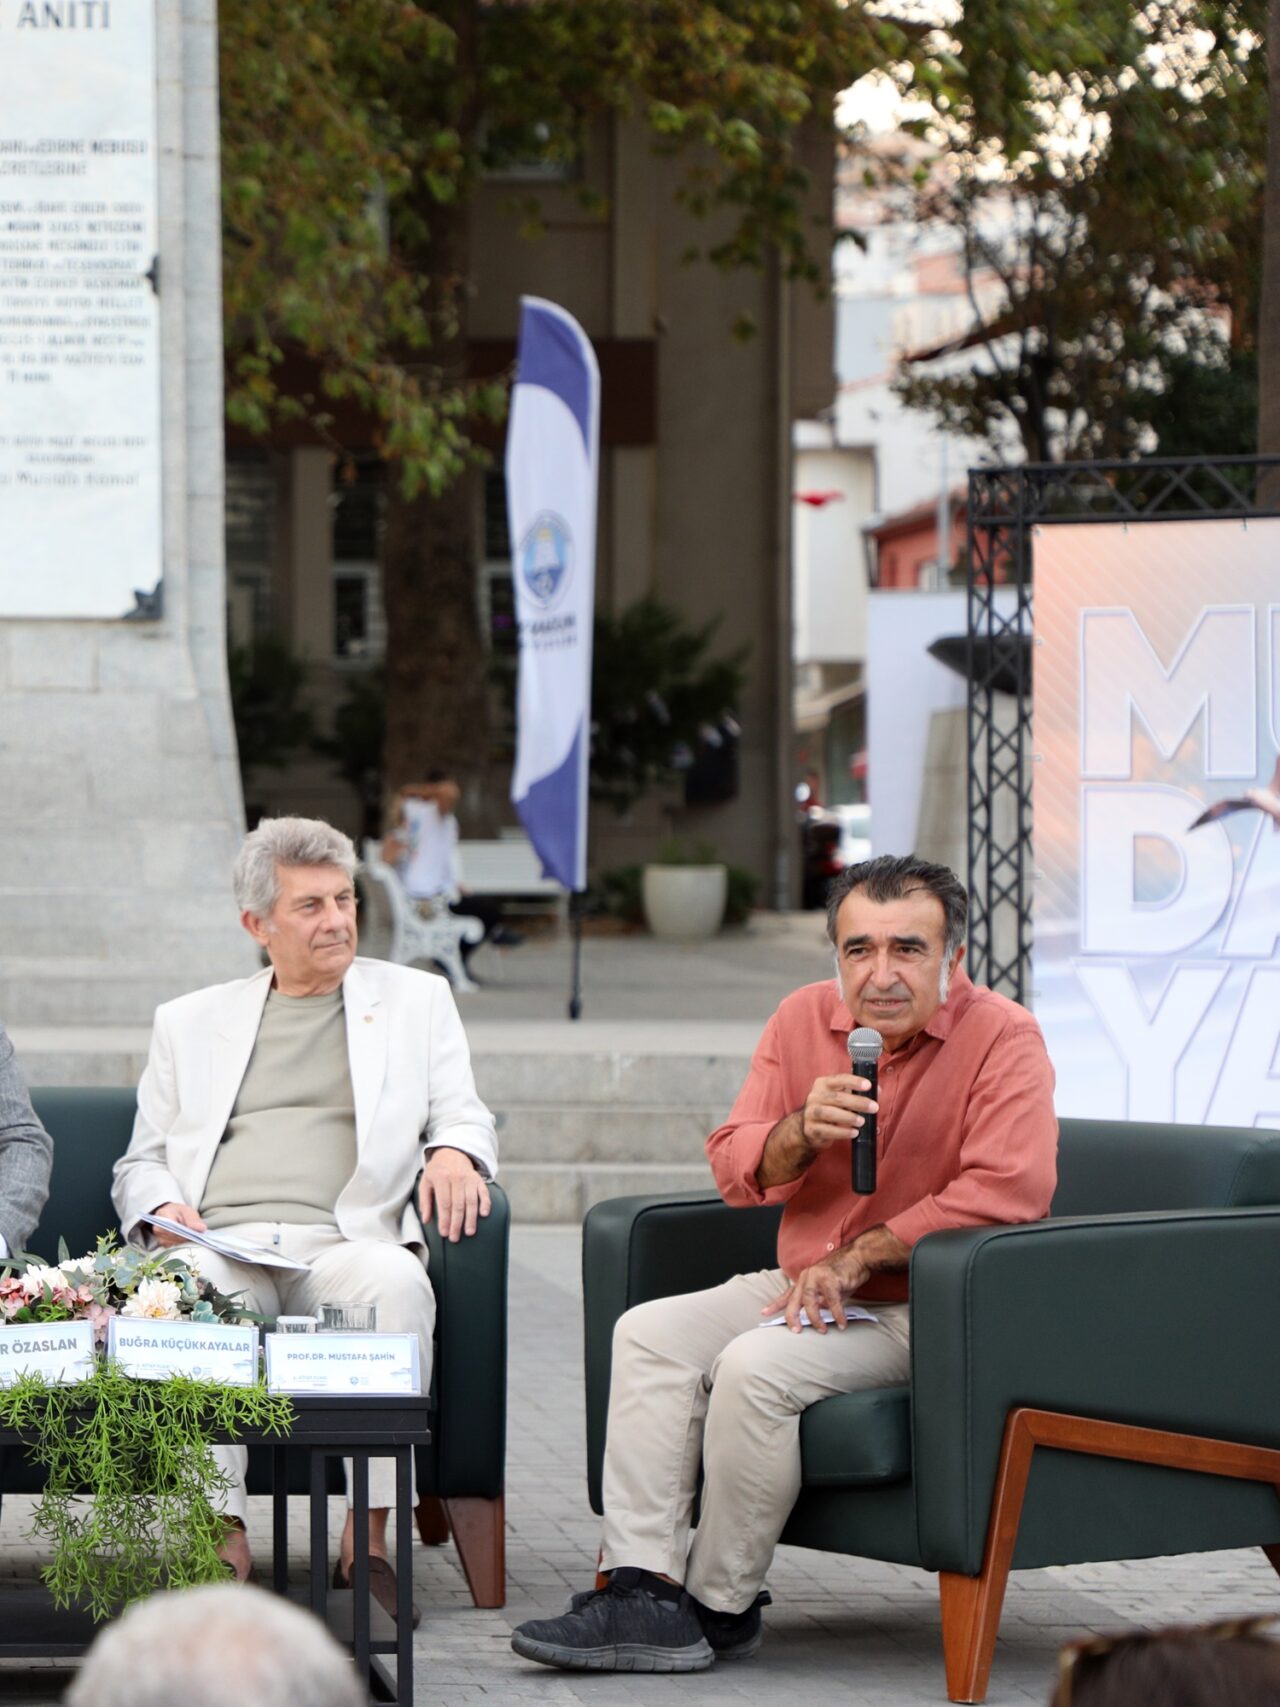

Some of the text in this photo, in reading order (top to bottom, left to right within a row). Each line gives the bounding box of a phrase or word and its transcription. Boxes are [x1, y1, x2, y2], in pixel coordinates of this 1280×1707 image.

[17, 1, 111, 29] ANITI
[1080, 604, 1280, 779] M
[12, 1338, 78, 1354] ÖZASLAN
[119, 1336, 250, 1352] BUĞRA KÜÇÜKKAYALAR
[328, 1353, 367, 1361] MUSTAFA
[369, 1352, 396, 1363] ŞAHİN
